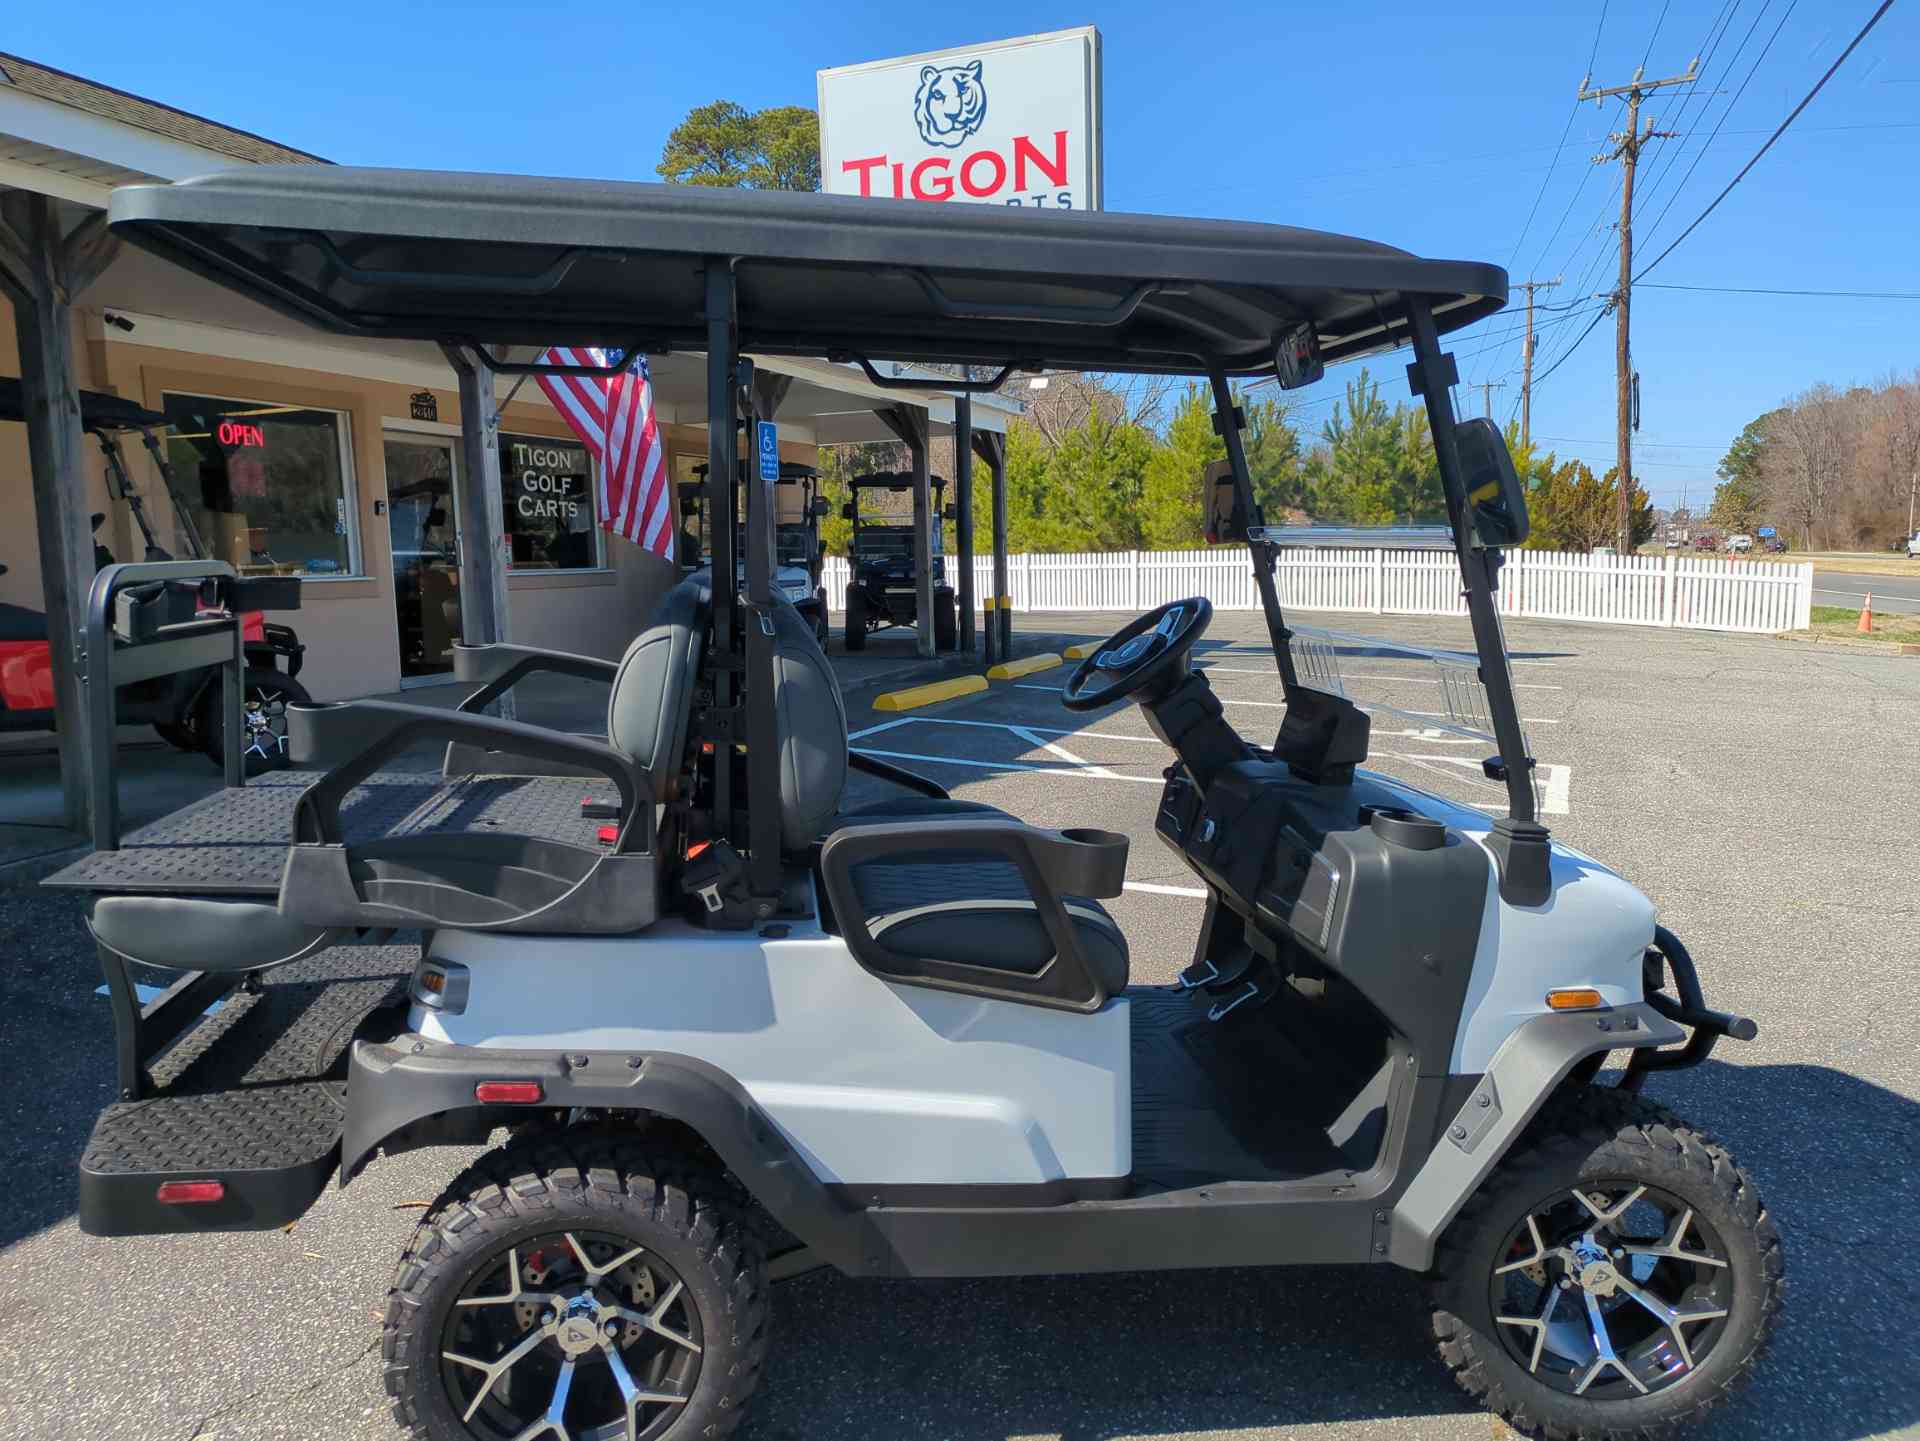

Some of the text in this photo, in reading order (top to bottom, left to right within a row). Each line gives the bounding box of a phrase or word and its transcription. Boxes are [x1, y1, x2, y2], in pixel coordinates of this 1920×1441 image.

[842, 130, 1069, 202] TIGON
[219, 422, 265, 448] OPEN
[513, 443, 571, 469] TIGON
[522, 470, 572, 494] GOLF
[518, 495, 578, 518] CARTS
